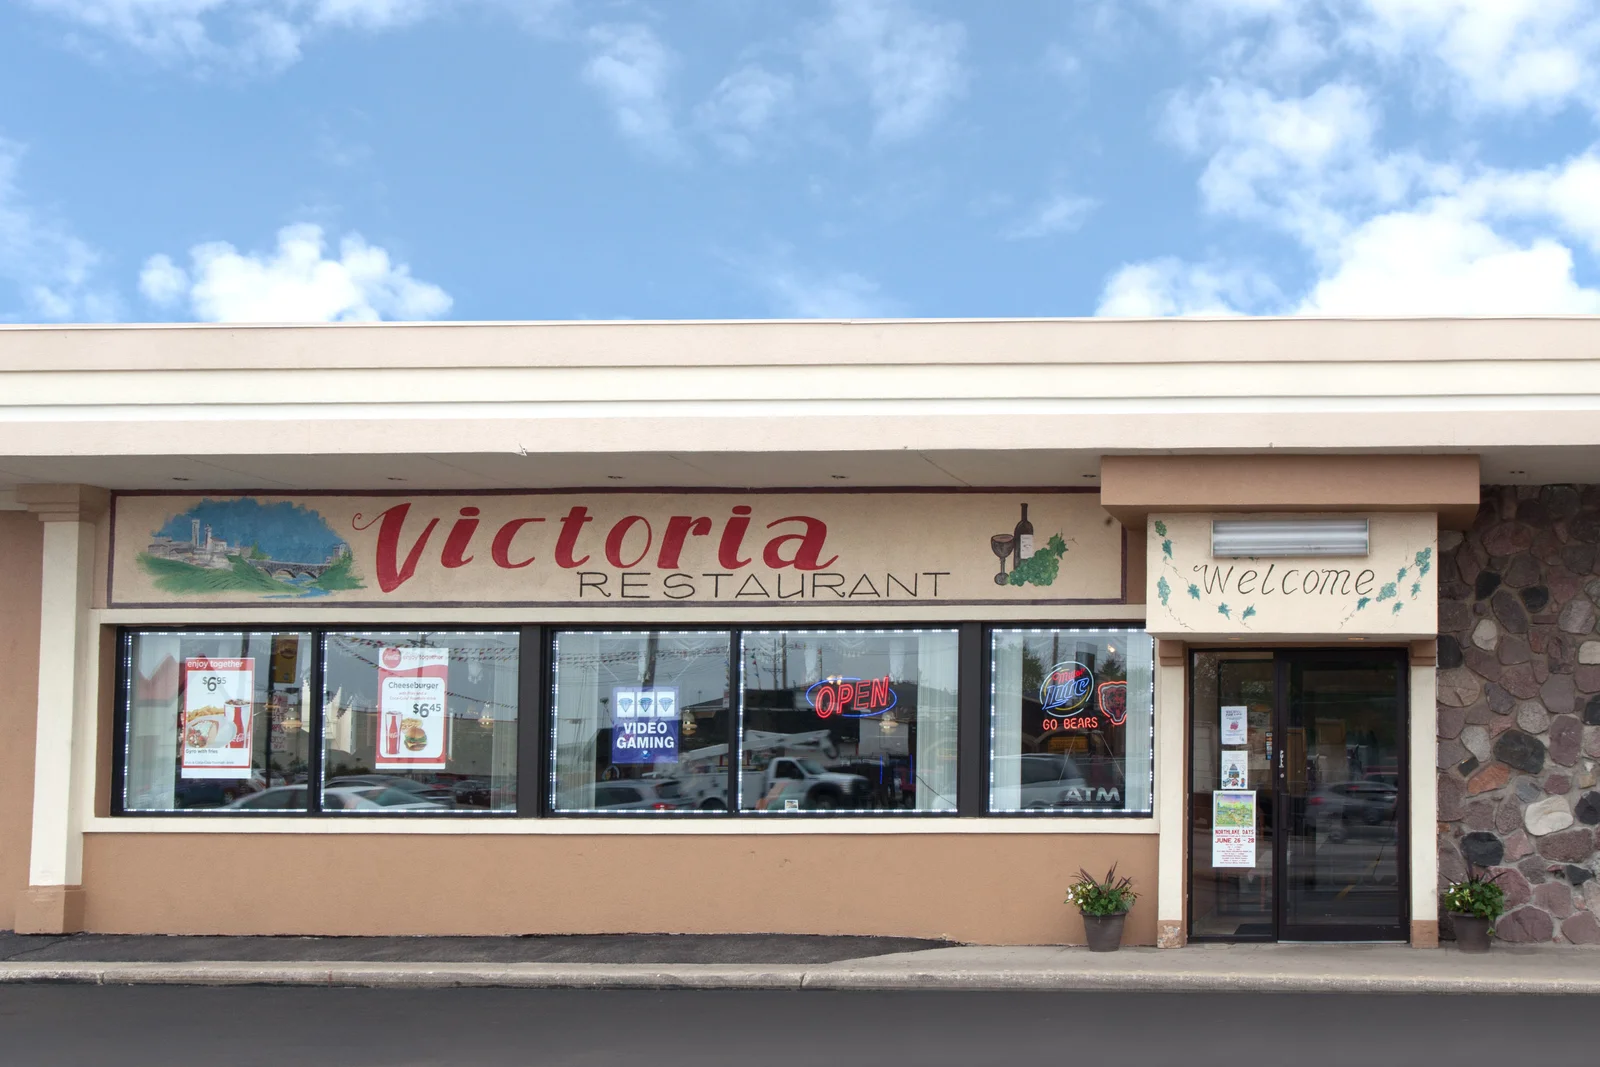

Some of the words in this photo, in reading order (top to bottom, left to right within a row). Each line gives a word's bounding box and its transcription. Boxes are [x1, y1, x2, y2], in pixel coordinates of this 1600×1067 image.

[352, 502, 838, 592] Victoria
[577, 571, 950, 600] RESTAURANT
[1193, 564, 1375, 596] Welcome
[187, 660, 208, 669] enjoy
[210, 660, 243, 669] together
[388, 681, 439, 691] Cheeseburger
[815, 675, 891, 719] OPEN
[623, 721, 667, 734] VIDEO
[1042, 718, 1058, 731] GO
[1063, 716, 1098, 730] BEARS
[616, 736, 675, 749] GAMING
[1065, 787, 1121, 802] ATM
